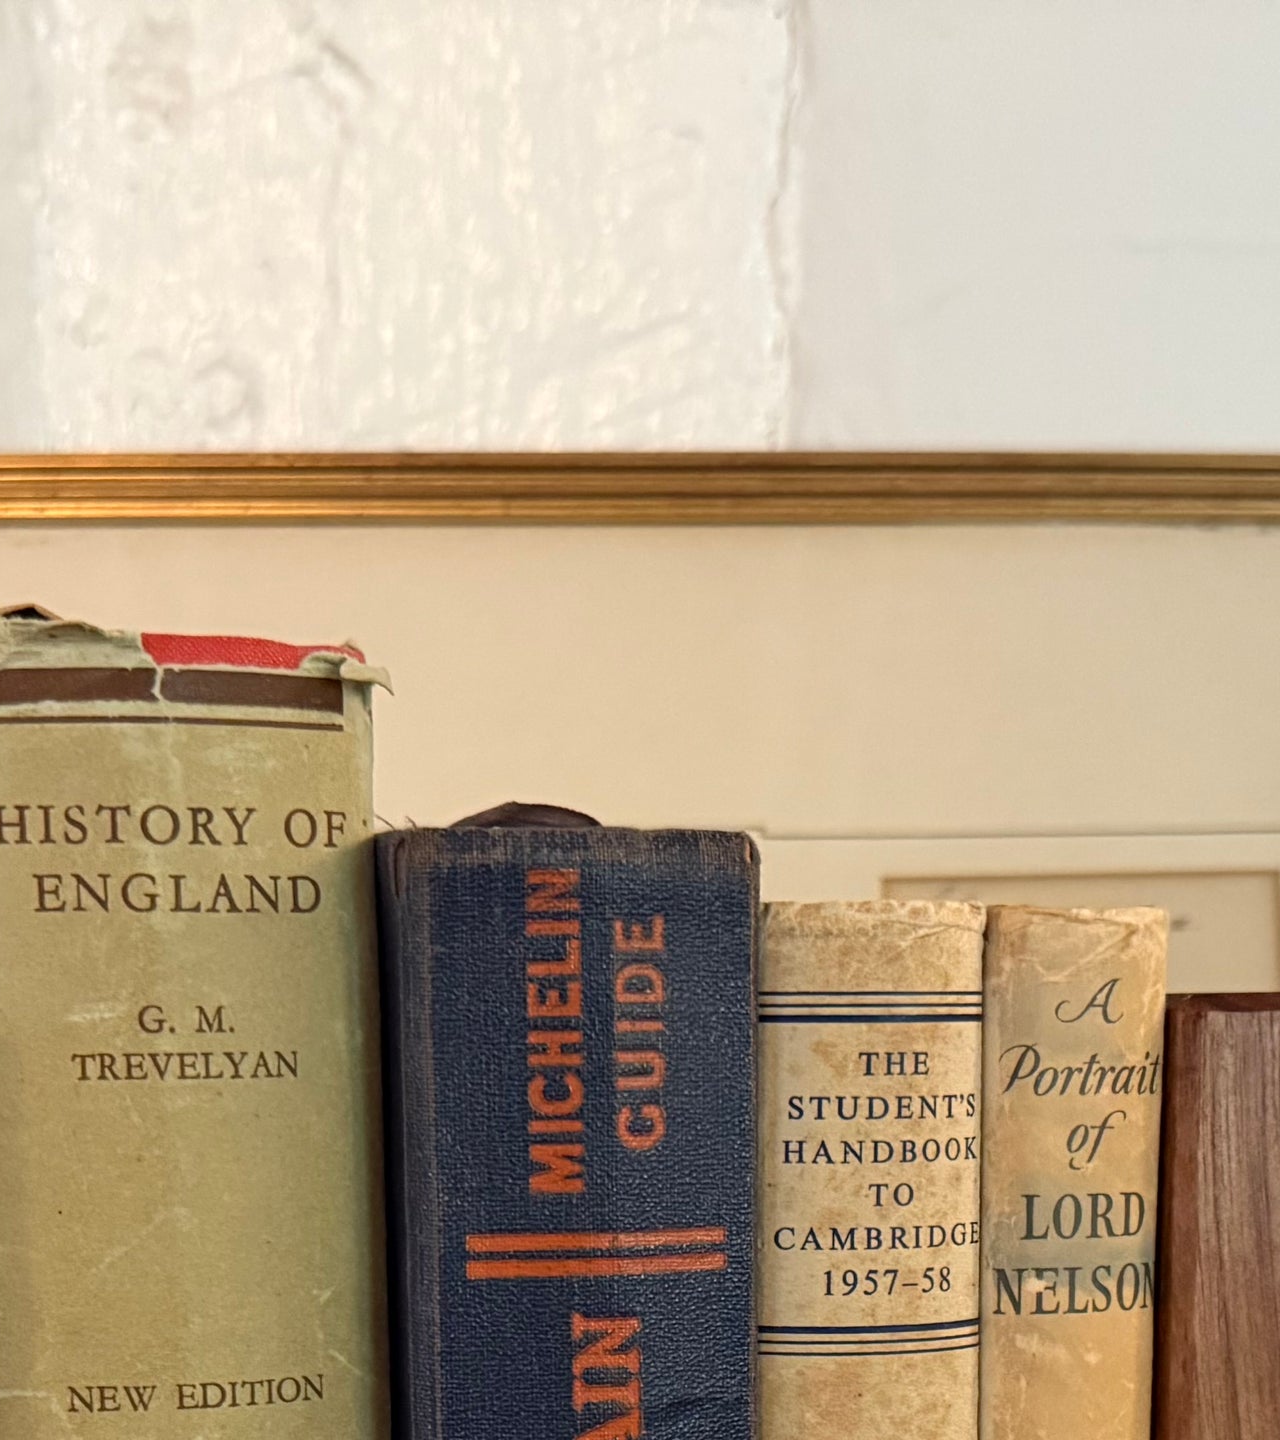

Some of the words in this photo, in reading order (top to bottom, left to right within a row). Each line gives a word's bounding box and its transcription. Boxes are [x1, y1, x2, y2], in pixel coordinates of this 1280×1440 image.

[284, 809, 347, 848] OF
[33, 873, 321, 914] ENGLAND
[137, 1004, 176, 1034] G.
[195, 1005, 236, 1034] M.
[1054, 977, 1124, 1025] A
[526, 869, 585, 1194] MICHELIN
[614, 914, 667, 1151] GUIDE
[72, 1050, 299, 1081] TREVELYAN
[858, 1051, 930, 1076] THE
[998, 1043, 1160, 1097] Portrait
[787, 1093, 976, 1120] STUDENT'S
[782, 1136, 977, 1164] HANDBOOK
[1066, 1109, 1126, 1170] of
[869, 1183, 914, 1207] TO
[773, 1221, 979, 1250] CAMBRIDGE
[1020, 1191, 1146, 1241] LORD
[992, 1261, 1156, 1317] NELSON
[67, 1384, 157, 1413] NEW
[176, 1373, 325, 1410] EDITION
